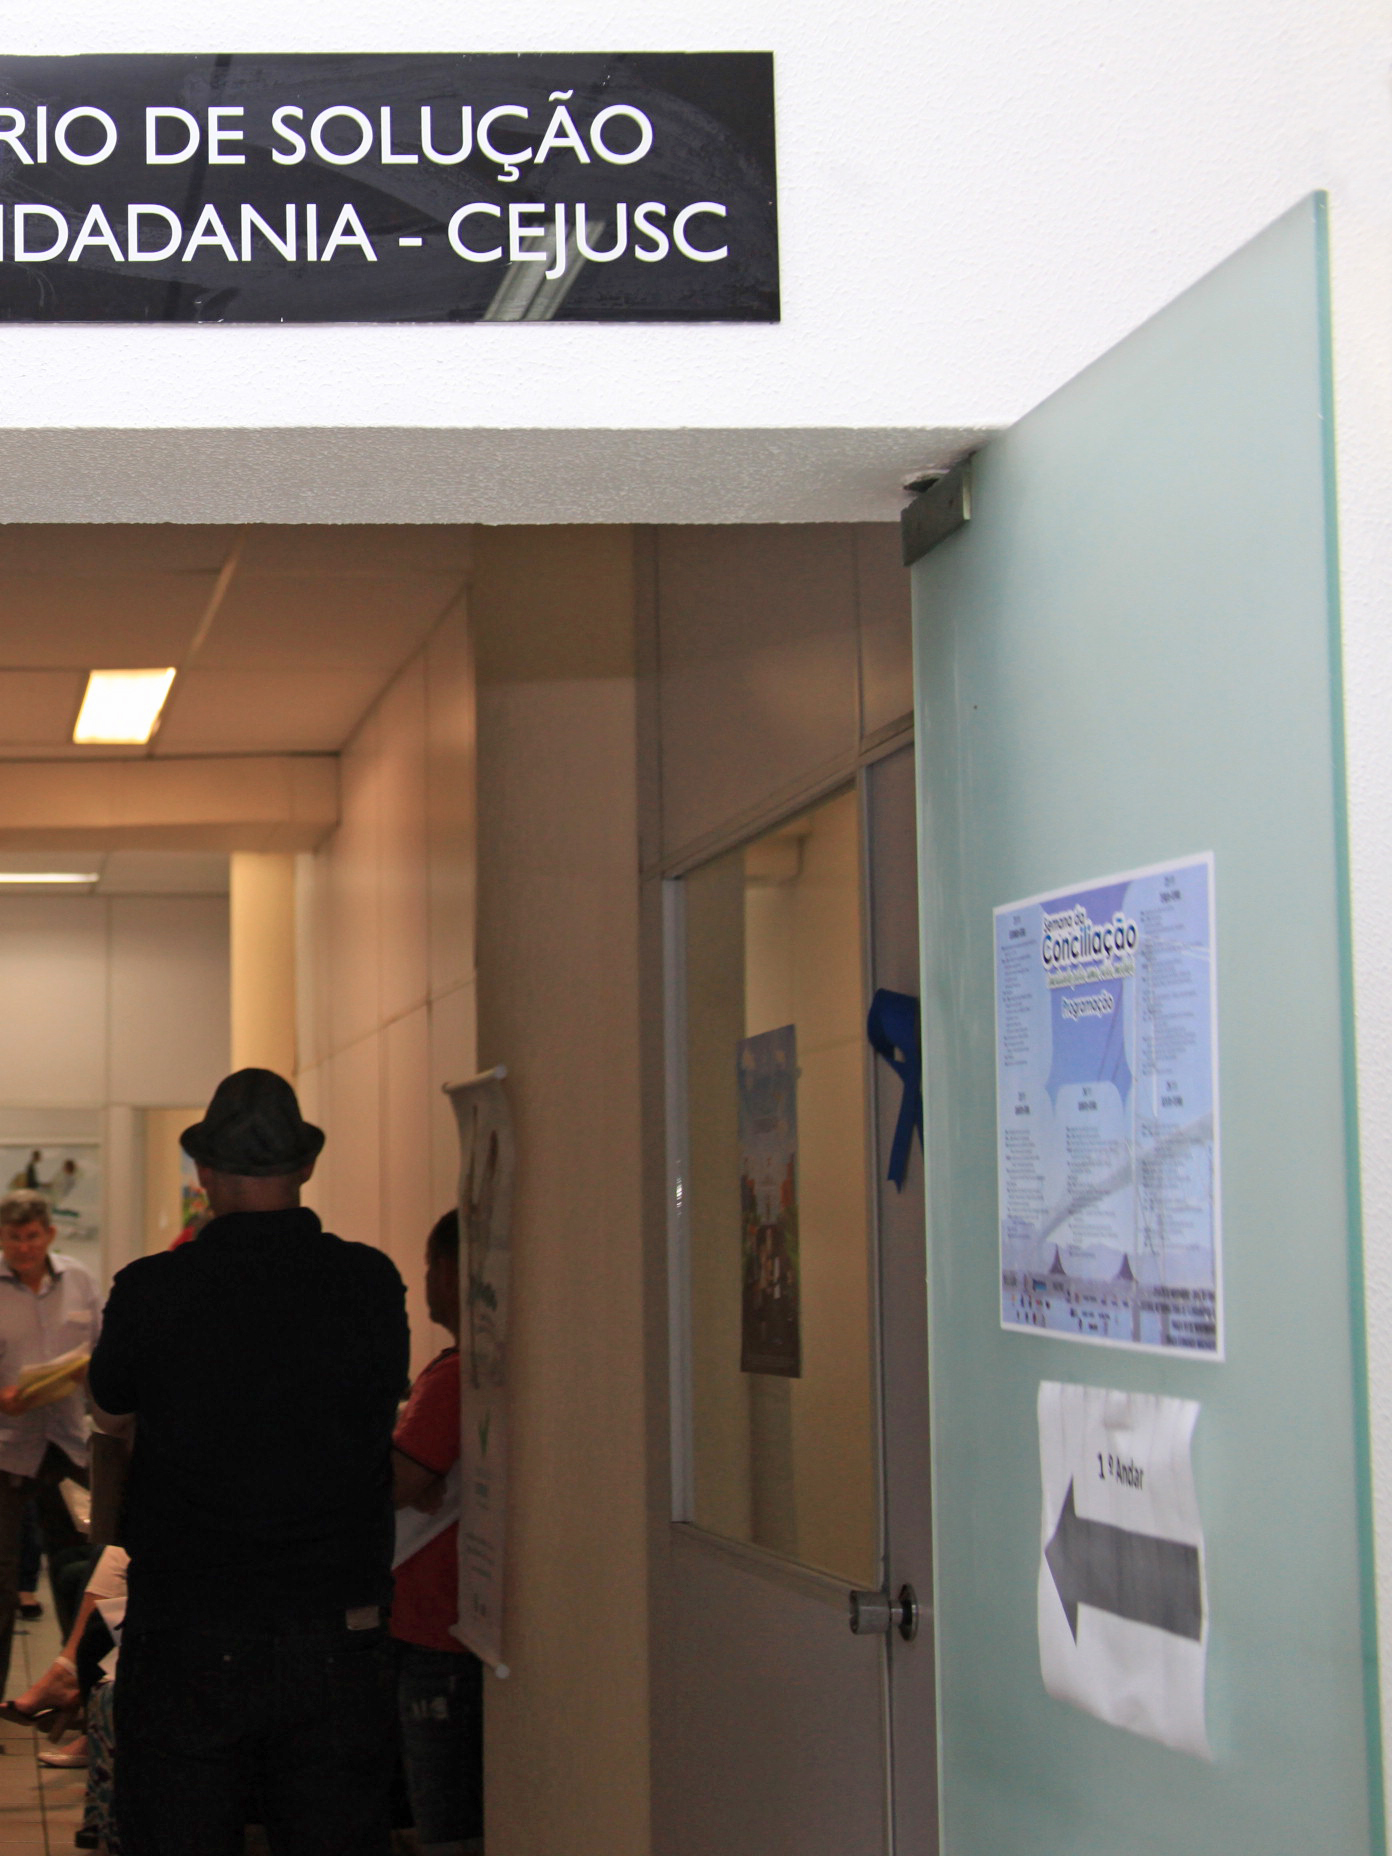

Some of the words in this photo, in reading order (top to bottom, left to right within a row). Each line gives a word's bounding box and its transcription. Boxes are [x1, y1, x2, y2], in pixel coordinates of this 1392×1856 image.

[145, 106, 246, 165] DE
[271, 90, 653, 182] SOLUÇÃO
[398, 236, 423, 247] -
[447, 201, 728, 280] CEJUSC
[1042, 917, 1138, 965] Conciliação
[1116, 1457, 1144, 1490] Andar
